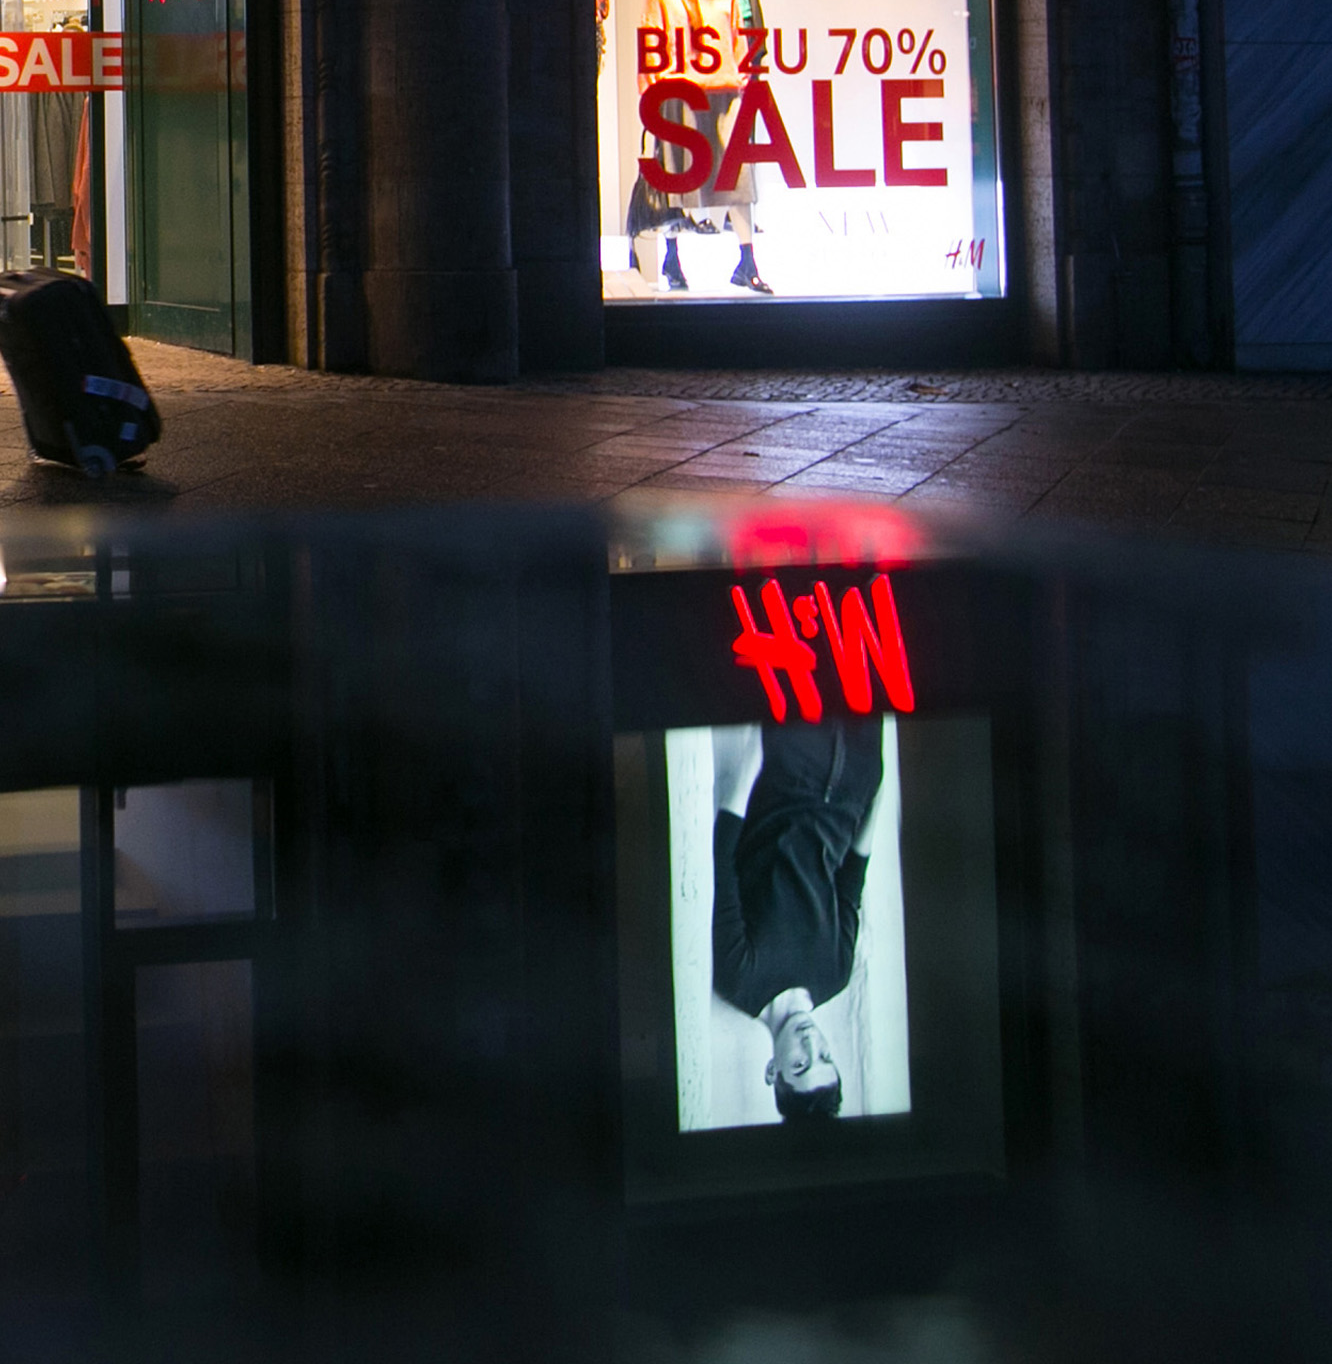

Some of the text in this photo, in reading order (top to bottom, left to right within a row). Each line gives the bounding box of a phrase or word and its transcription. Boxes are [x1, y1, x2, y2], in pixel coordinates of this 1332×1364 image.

[637, 26, 947, 75] BIS ZU 70%
[638, 77, 948, 194] SALE
[945, 238, 985, 270] HM
